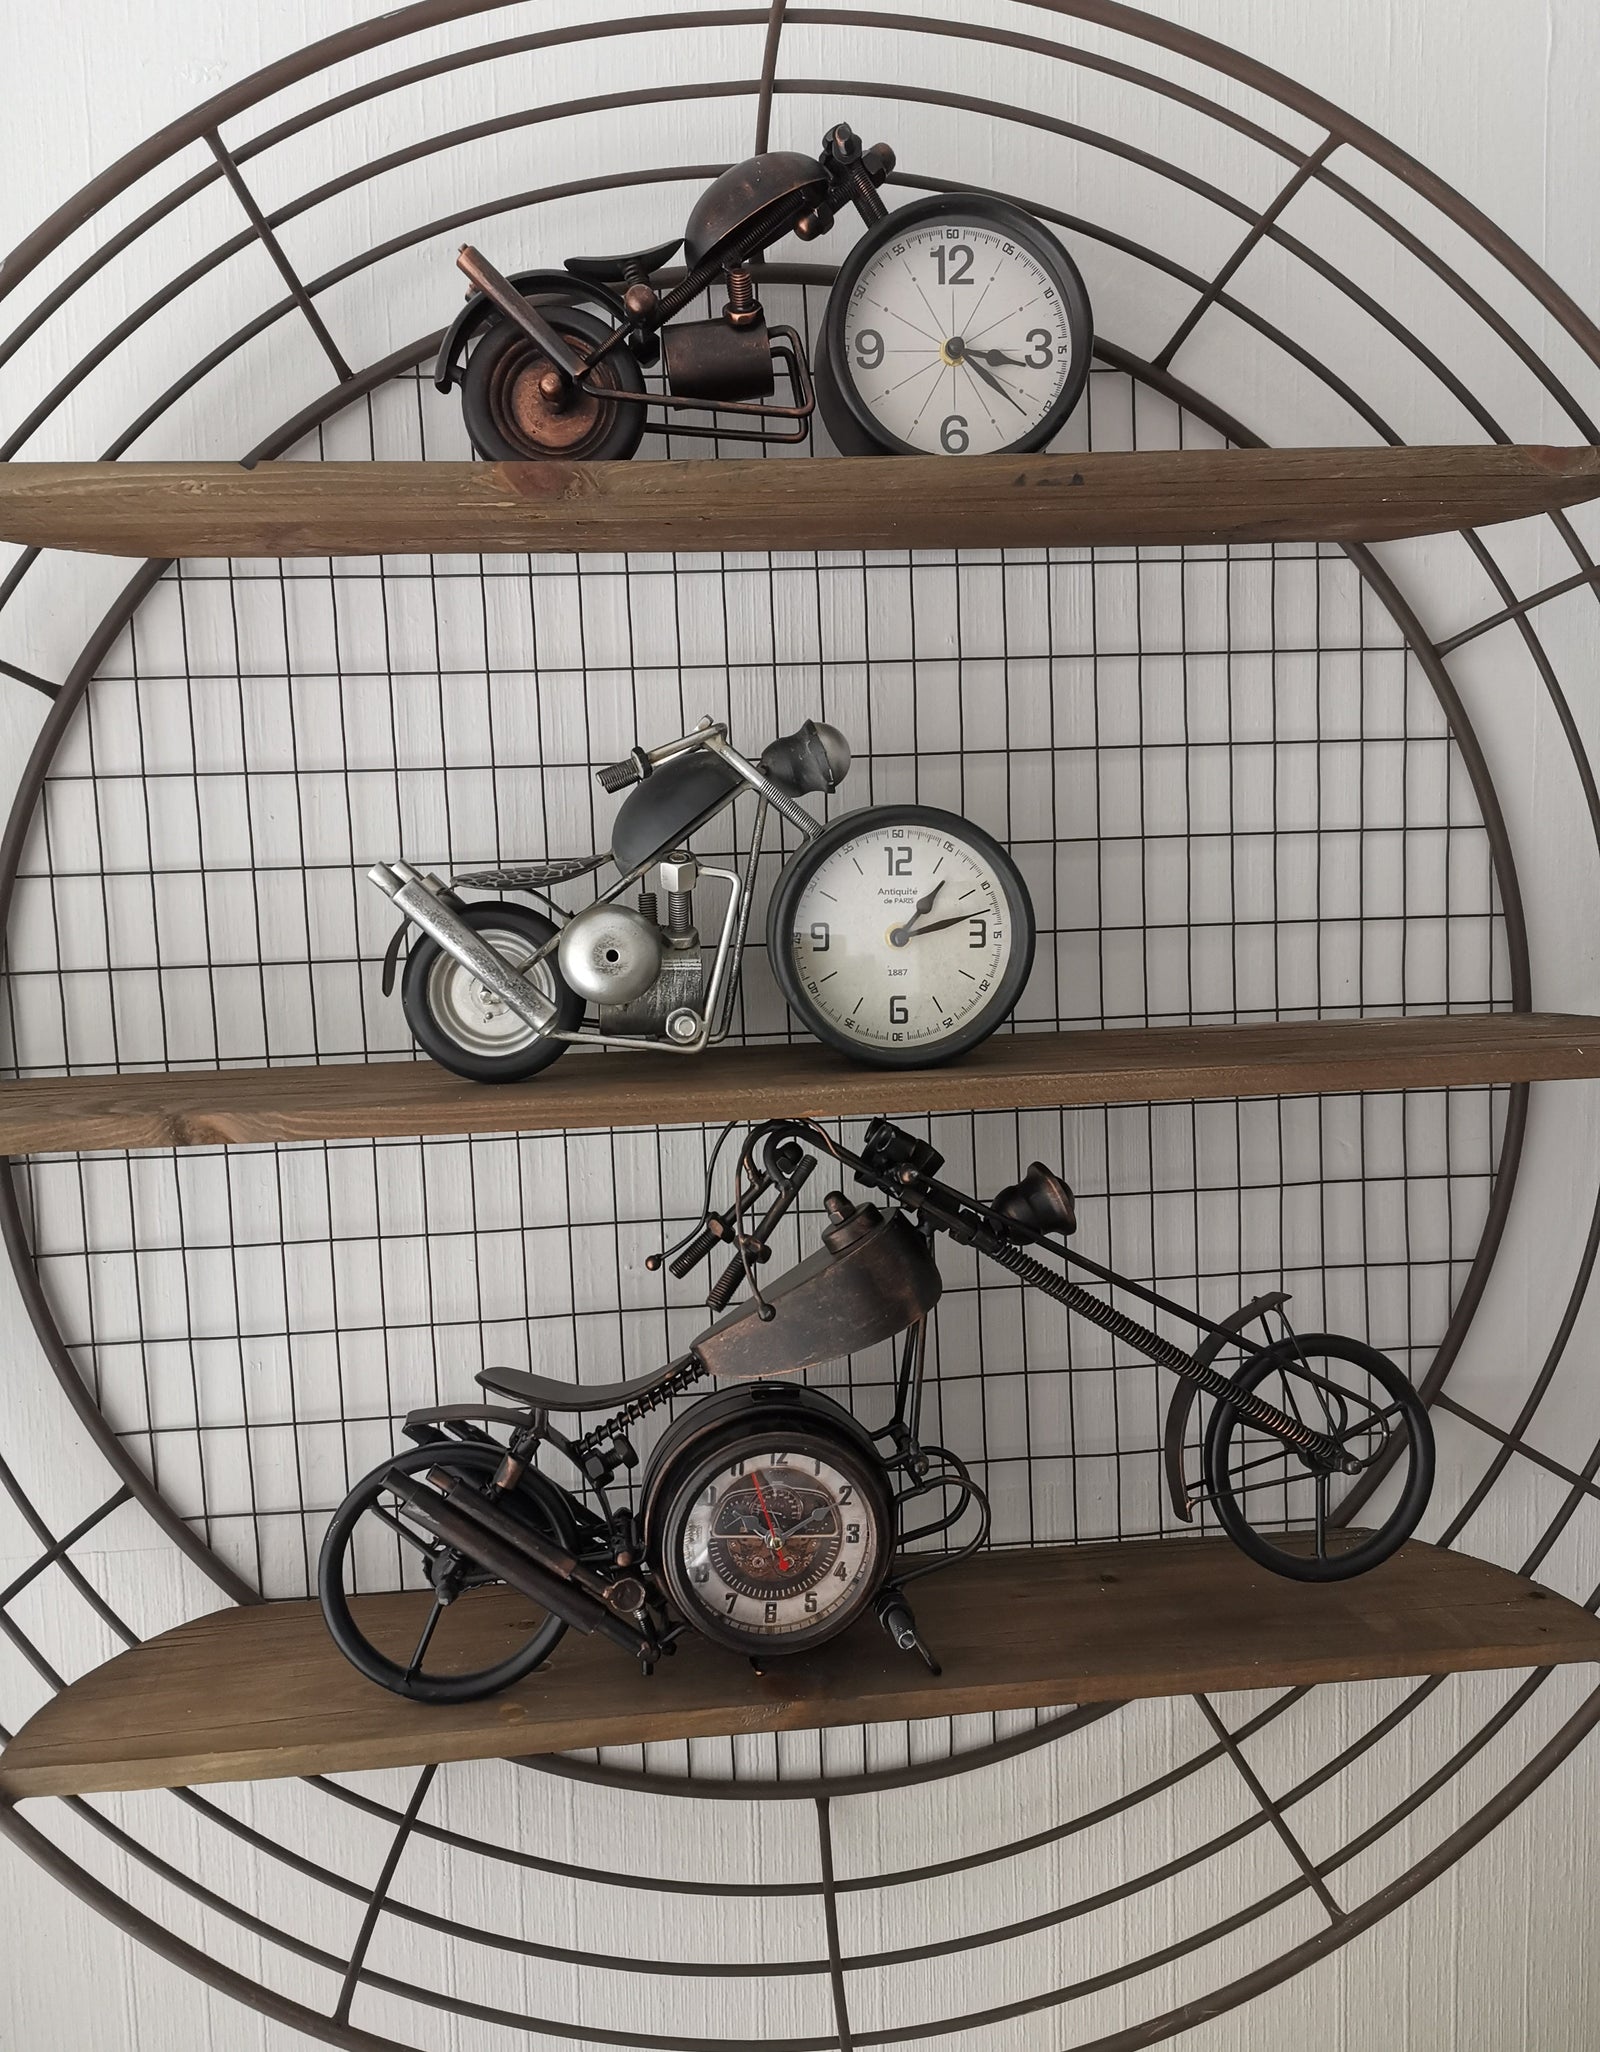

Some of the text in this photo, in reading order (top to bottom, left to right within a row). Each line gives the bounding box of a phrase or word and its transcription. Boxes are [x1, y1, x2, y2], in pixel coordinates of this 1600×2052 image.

[946, 229, 959, 239] 60
[893, 243, 905, 255] 55
[1002, 242, 1014, 256] 05
[930, 245, 974, 285] 12
[854, 285, 866, 299] 50
[1043, 286, 1054, 299] 10
[855, 329, 885, 370] 9
[1024, 329, 1053, 370] 3
[940, 415, 969, 454] 6
[892, 830, 904, 838] 60
[843, 844, 854, 854] 55
[943, 841, 955, 852] 05
[884, 847, 913, 876] 12
[878, 888, 918, 896] Antiquité
[980, 881, 990, 890] 10
[811, 922, 830, 952] 9
[969, 920, 986, 948] 3
[890, 995, 908, 1024] 6
[943, 1017, 953, 1028] 25
[892, 1032, 903, 1041] 30
[771, 1453, 788, 1466] 12
[814, 1461, 821, 1475] 1
[839, 1486, 853, 1505] 2
[846, 1524, 860, 1543] 3
[833, 1562, 848, 1582] 4
[726, 1593, 737, 1613] 7
[805, 1593, 817, 1612] 5
[765, 1602, 777, 1623] 6
